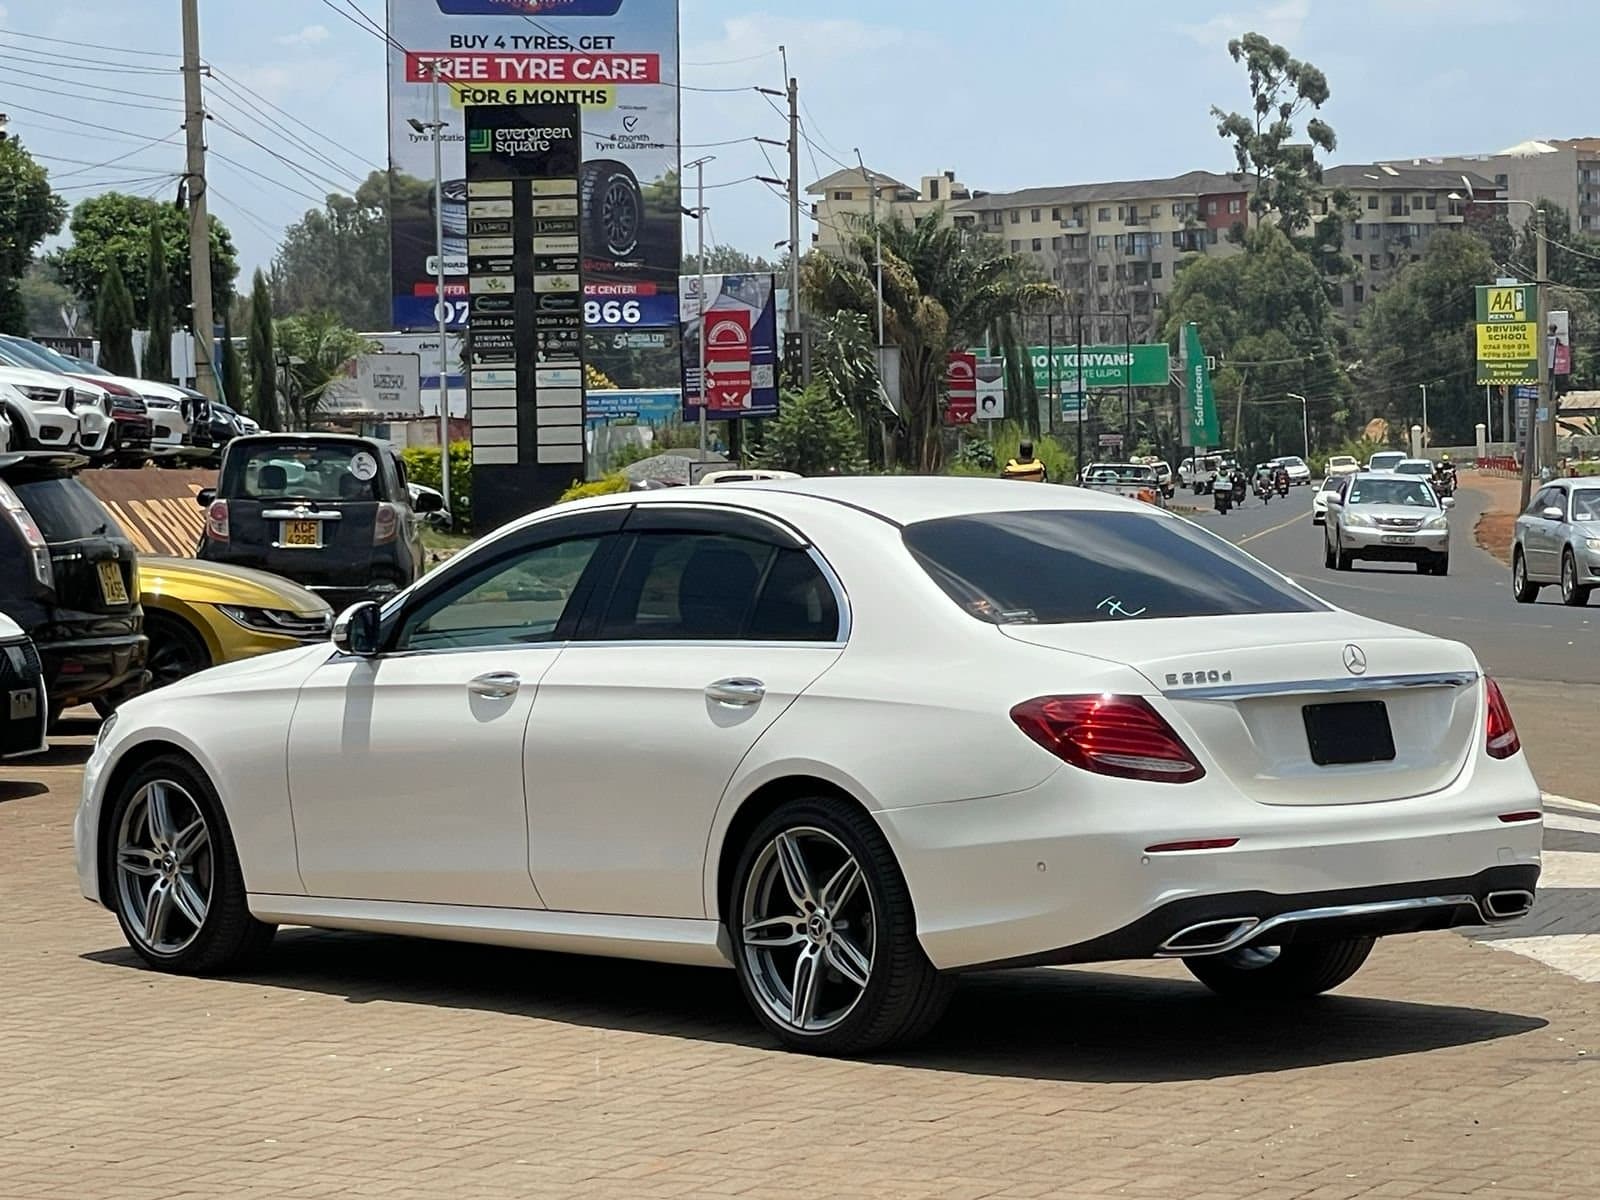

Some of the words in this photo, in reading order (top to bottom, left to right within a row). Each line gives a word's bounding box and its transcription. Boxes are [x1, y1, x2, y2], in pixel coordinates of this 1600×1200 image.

[450, 35, 488, 49] BUY
[494, 36, 506, 49] 4
[511, 36, 574, 52] TYRES,
[580, 36, 615, 50] GET
[418, 57, 488, 79] FREE
[494, 57, 565, 79] TYRE
[572, 58, 648, 79] CARE
[460, 90, 499, 103] FOR
[506, 90, 517, 104] 6
[523, 90, 607, 104] MONTHS
[409, 134, 429, 142] Tyre
[495, 127, 572, 144] evergreen
[495, 139, 550, 156] square
[596, 142, 615, 151] Tyre
[1491, 291, 1513, 311] AA
[584, 301, 640, 324] 866
[1486, 325, 1527, 333] DRIVING
[1194, 365, 1205, 427] Safaricom
